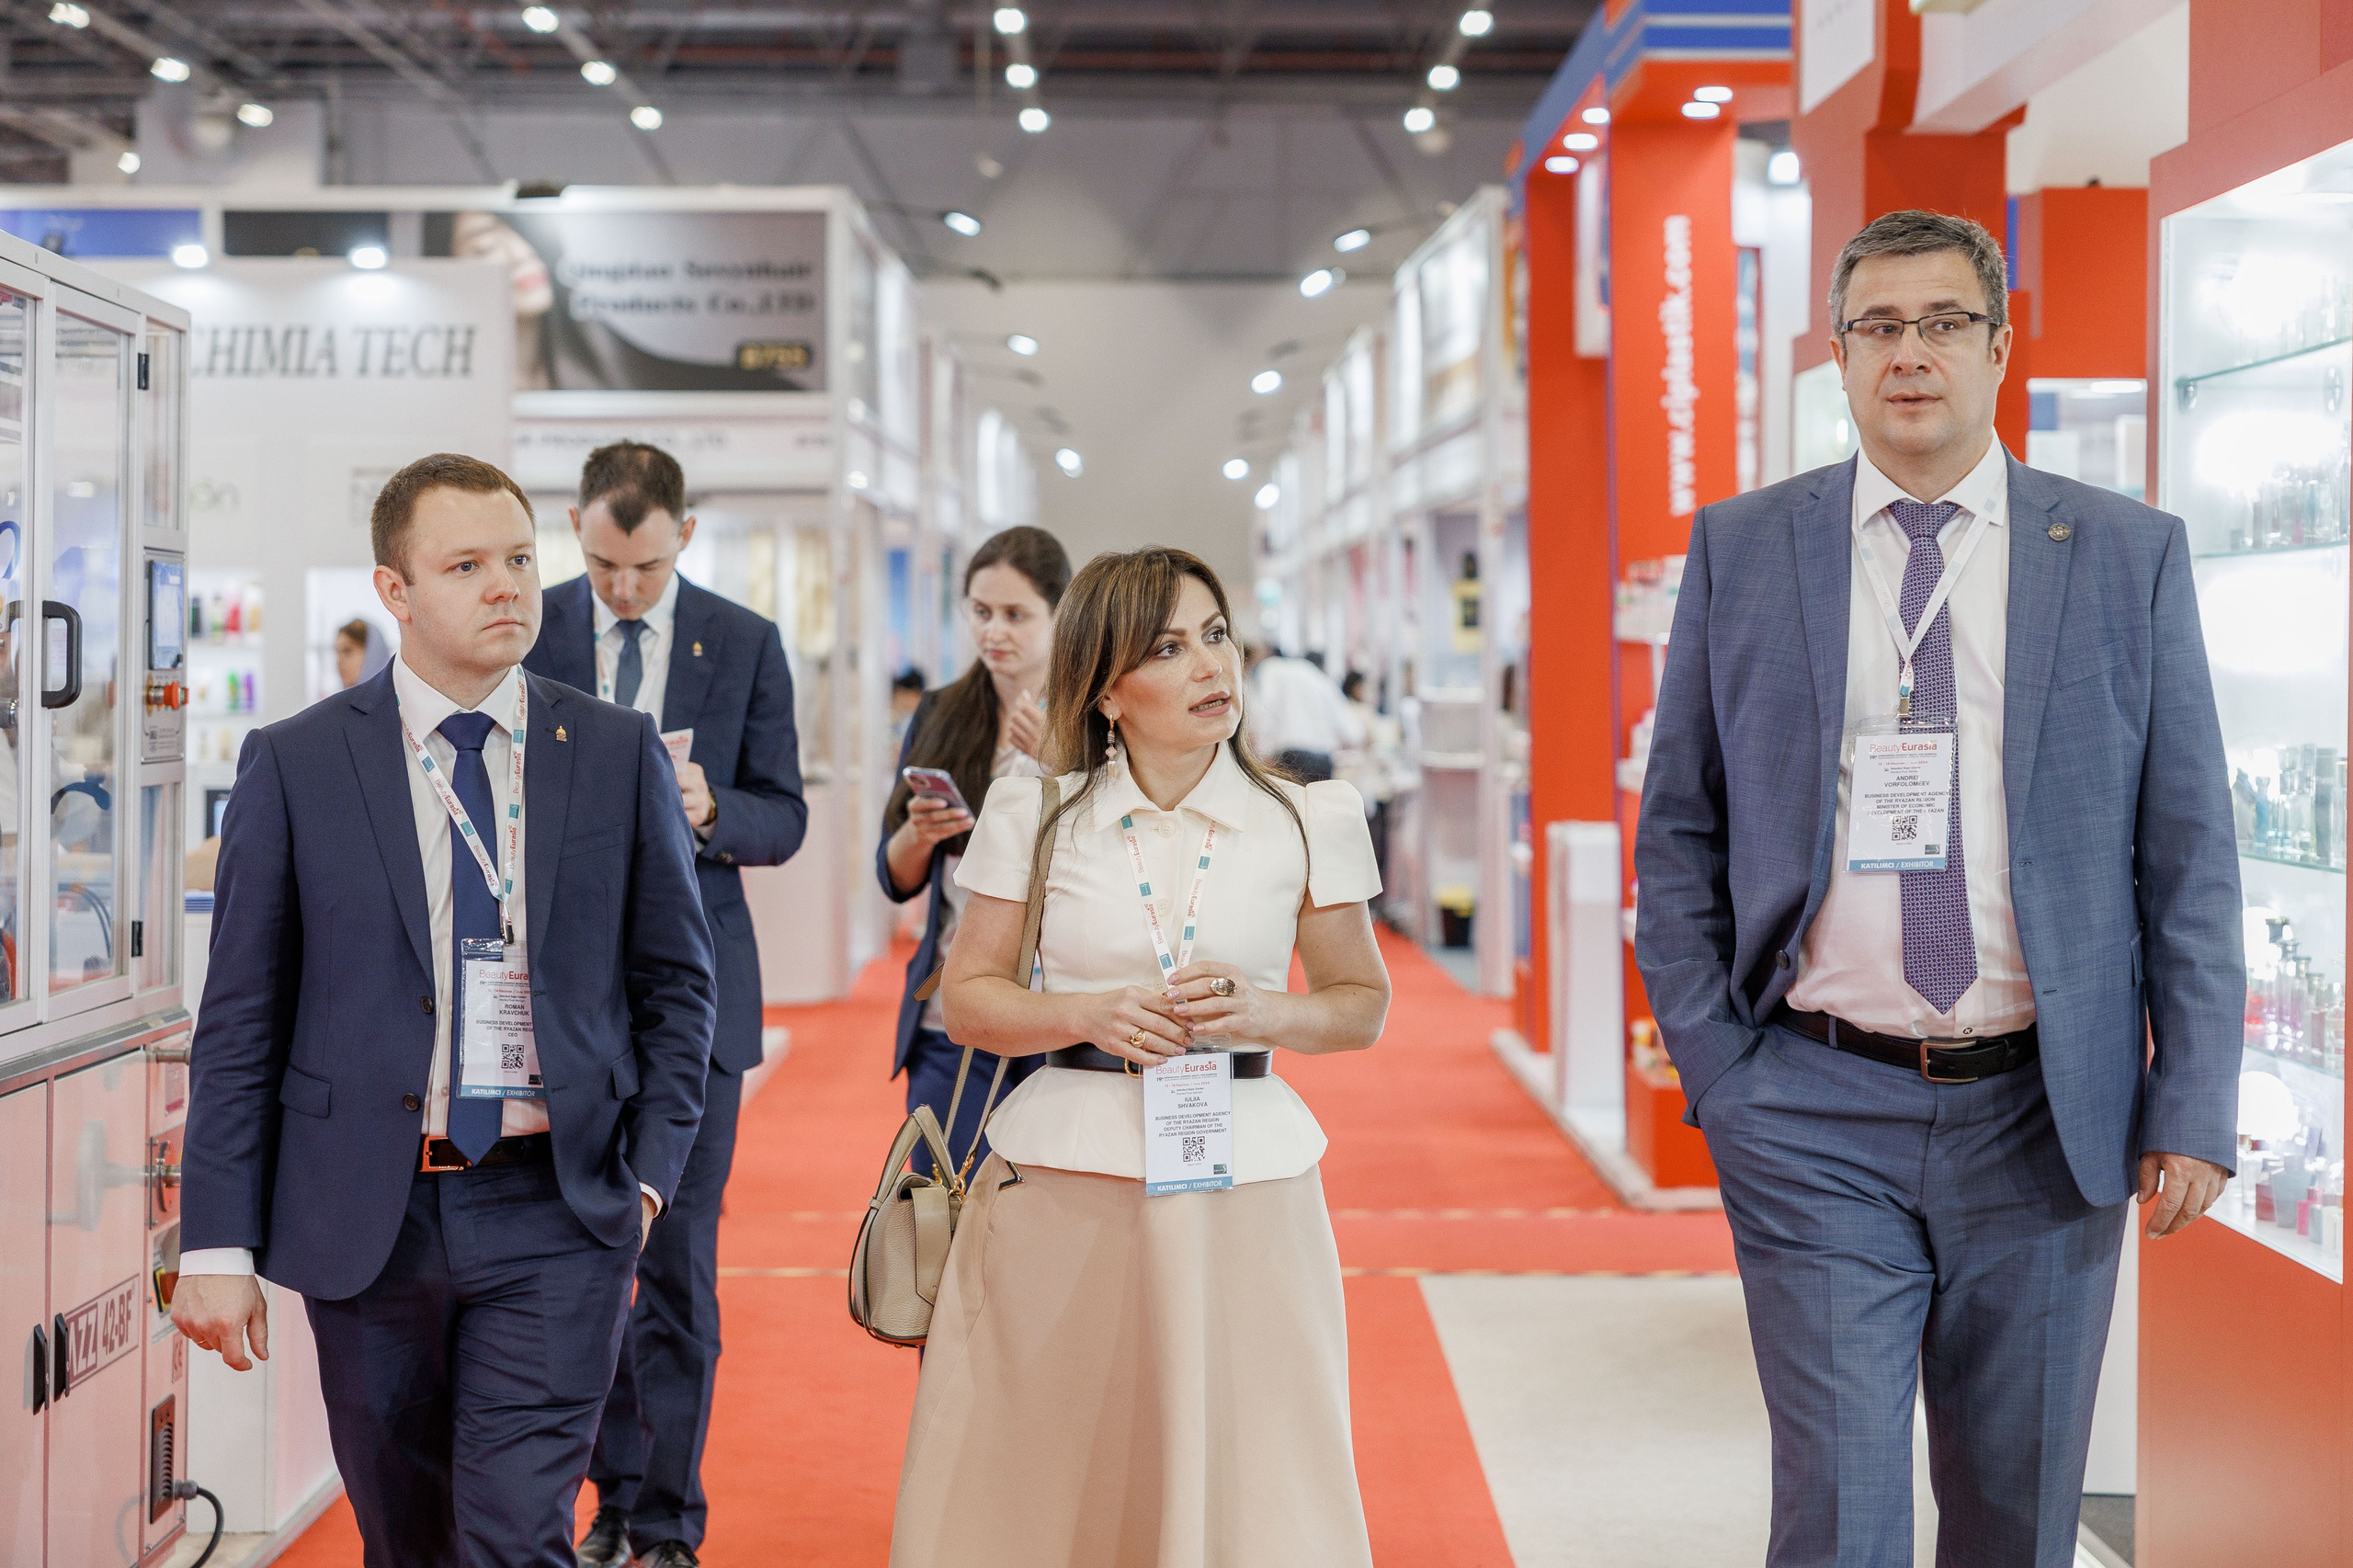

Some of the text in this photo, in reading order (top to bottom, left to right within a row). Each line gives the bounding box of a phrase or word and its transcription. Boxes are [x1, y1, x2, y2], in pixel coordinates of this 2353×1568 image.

[352, 324, 476, 379] TECH
[1870, 741, 1938, 754] BeautyEurasia
[435, 778, 460, 816] BeautyEurasia
[473, 845, 494, 887] BeautyEurasia
[479, 970, 529, 981] BeautyEura
[1155, 1062, 1217, 1075] BeautyEurasia
[1157, 1183, 1188, 1191] KATILIMCI
[1193, 1180, 1222, 1188] EXHIBITOR
[102, 1290, 131, 1356] 42-BF
